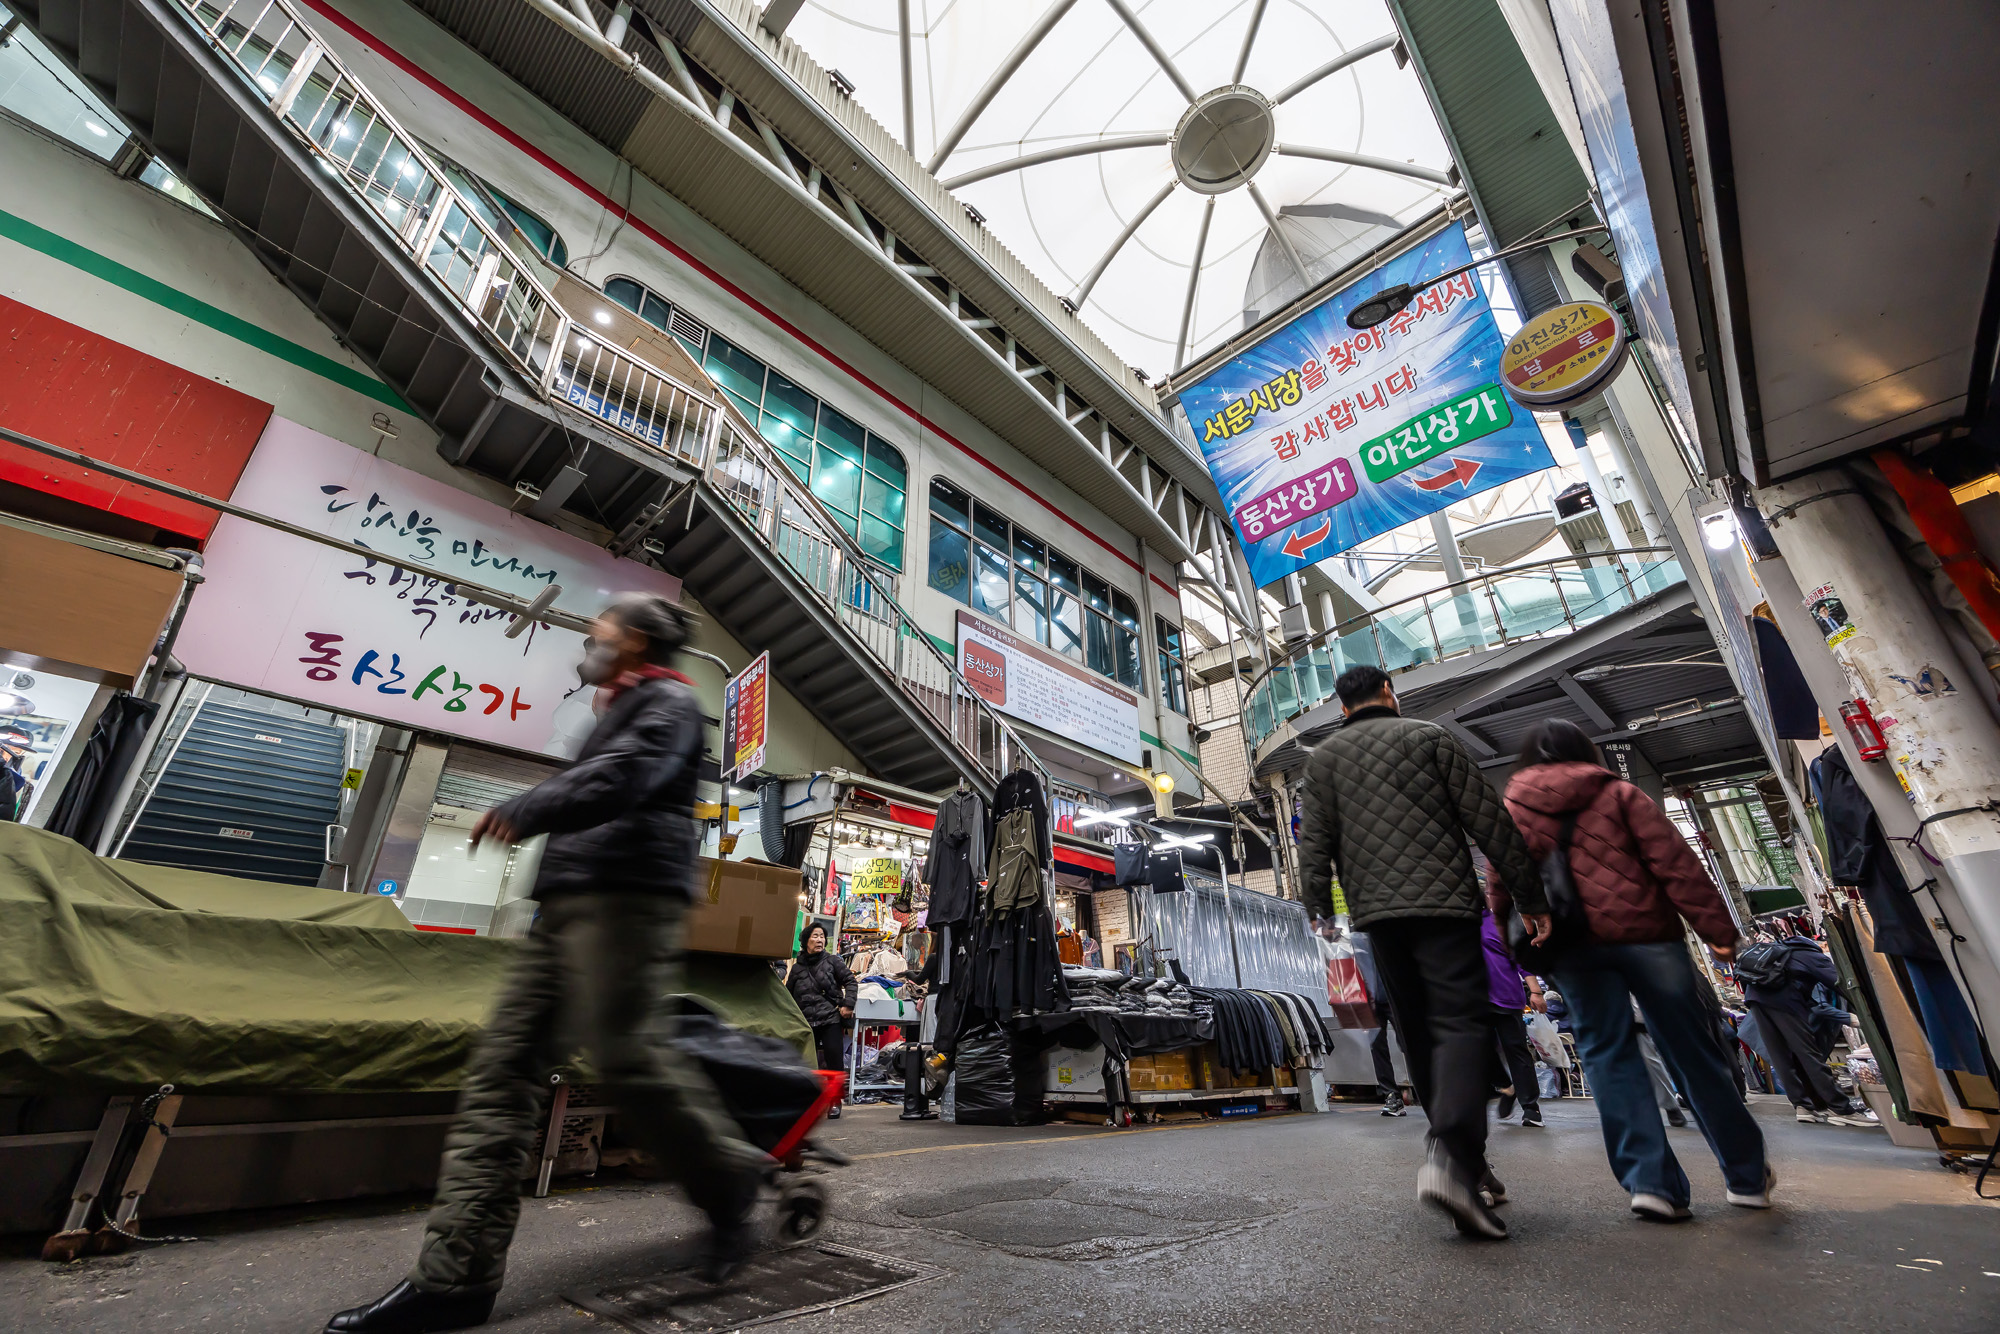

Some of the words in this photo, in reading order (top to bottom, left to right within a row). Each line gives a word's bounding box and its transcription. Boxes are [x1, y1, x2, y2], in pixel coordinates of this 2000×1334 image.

[1511, 306, 1589, 355] 아진상가
[1514, 350, 1537, 365] Daegu
[1538, 334, 1568, 352] Seomun
[1568, 317, 1597, 334] Market
[1569, 345, 1608, 369] 소방통로
[1202, 356, 1328, 443] 서문시장을
[1270, 365, 1418, 462] 감사합니다
[1367, 389, 1499, 467] 아진상가
[320, 484, 442, 567] 당신을
[452, 538, 558, 585] 만나서
[1242, 463, 1347, 537] 동산상가
[299, 630, 532, 722] 동산상가
[965, 652, 1005, 682] 동산상가
[1605, 743, 1631, 751] 서문시장
